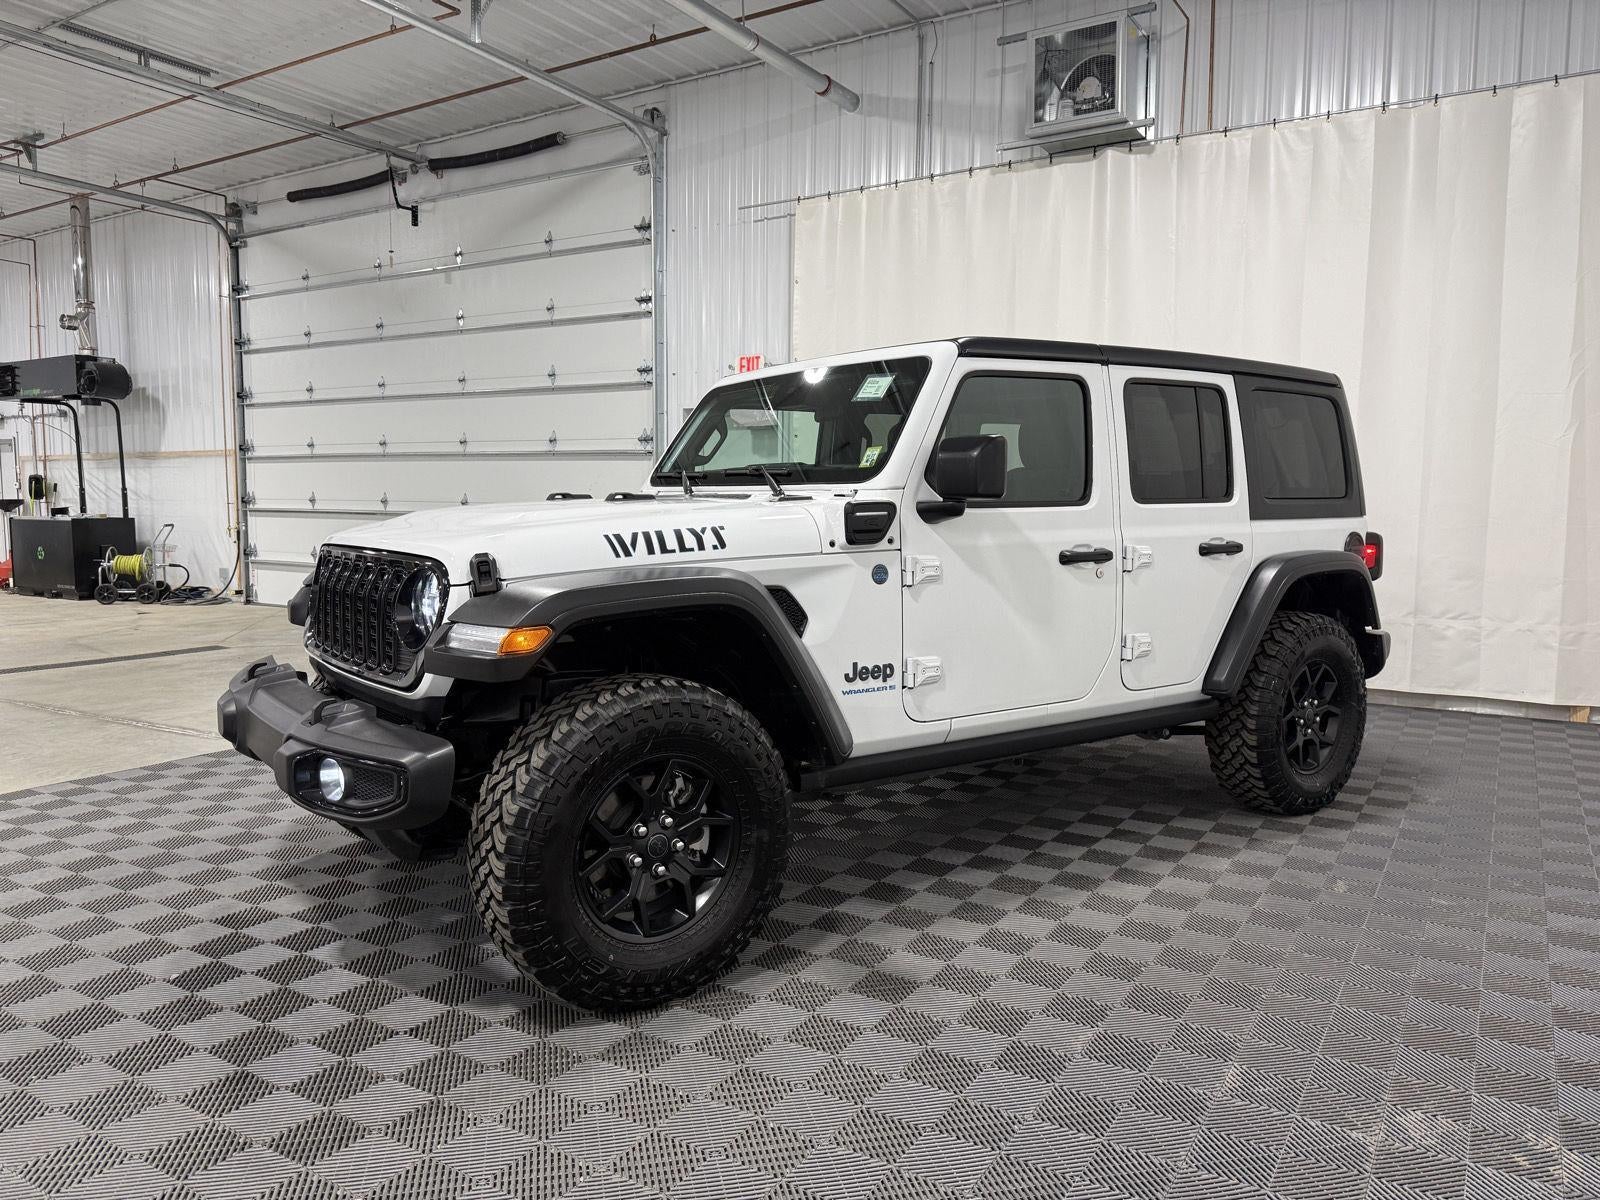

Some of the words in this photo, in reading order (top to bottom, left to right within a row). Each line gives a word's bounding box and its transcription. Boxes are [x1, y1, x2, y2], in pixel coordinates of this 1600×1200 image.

[740, 356, 760, 373] EXIT
[603, 525, 727, 559] WILLYS
[844, 661, 895, 683] Jeep
[842, 685, 888, 696] WRANGLER
